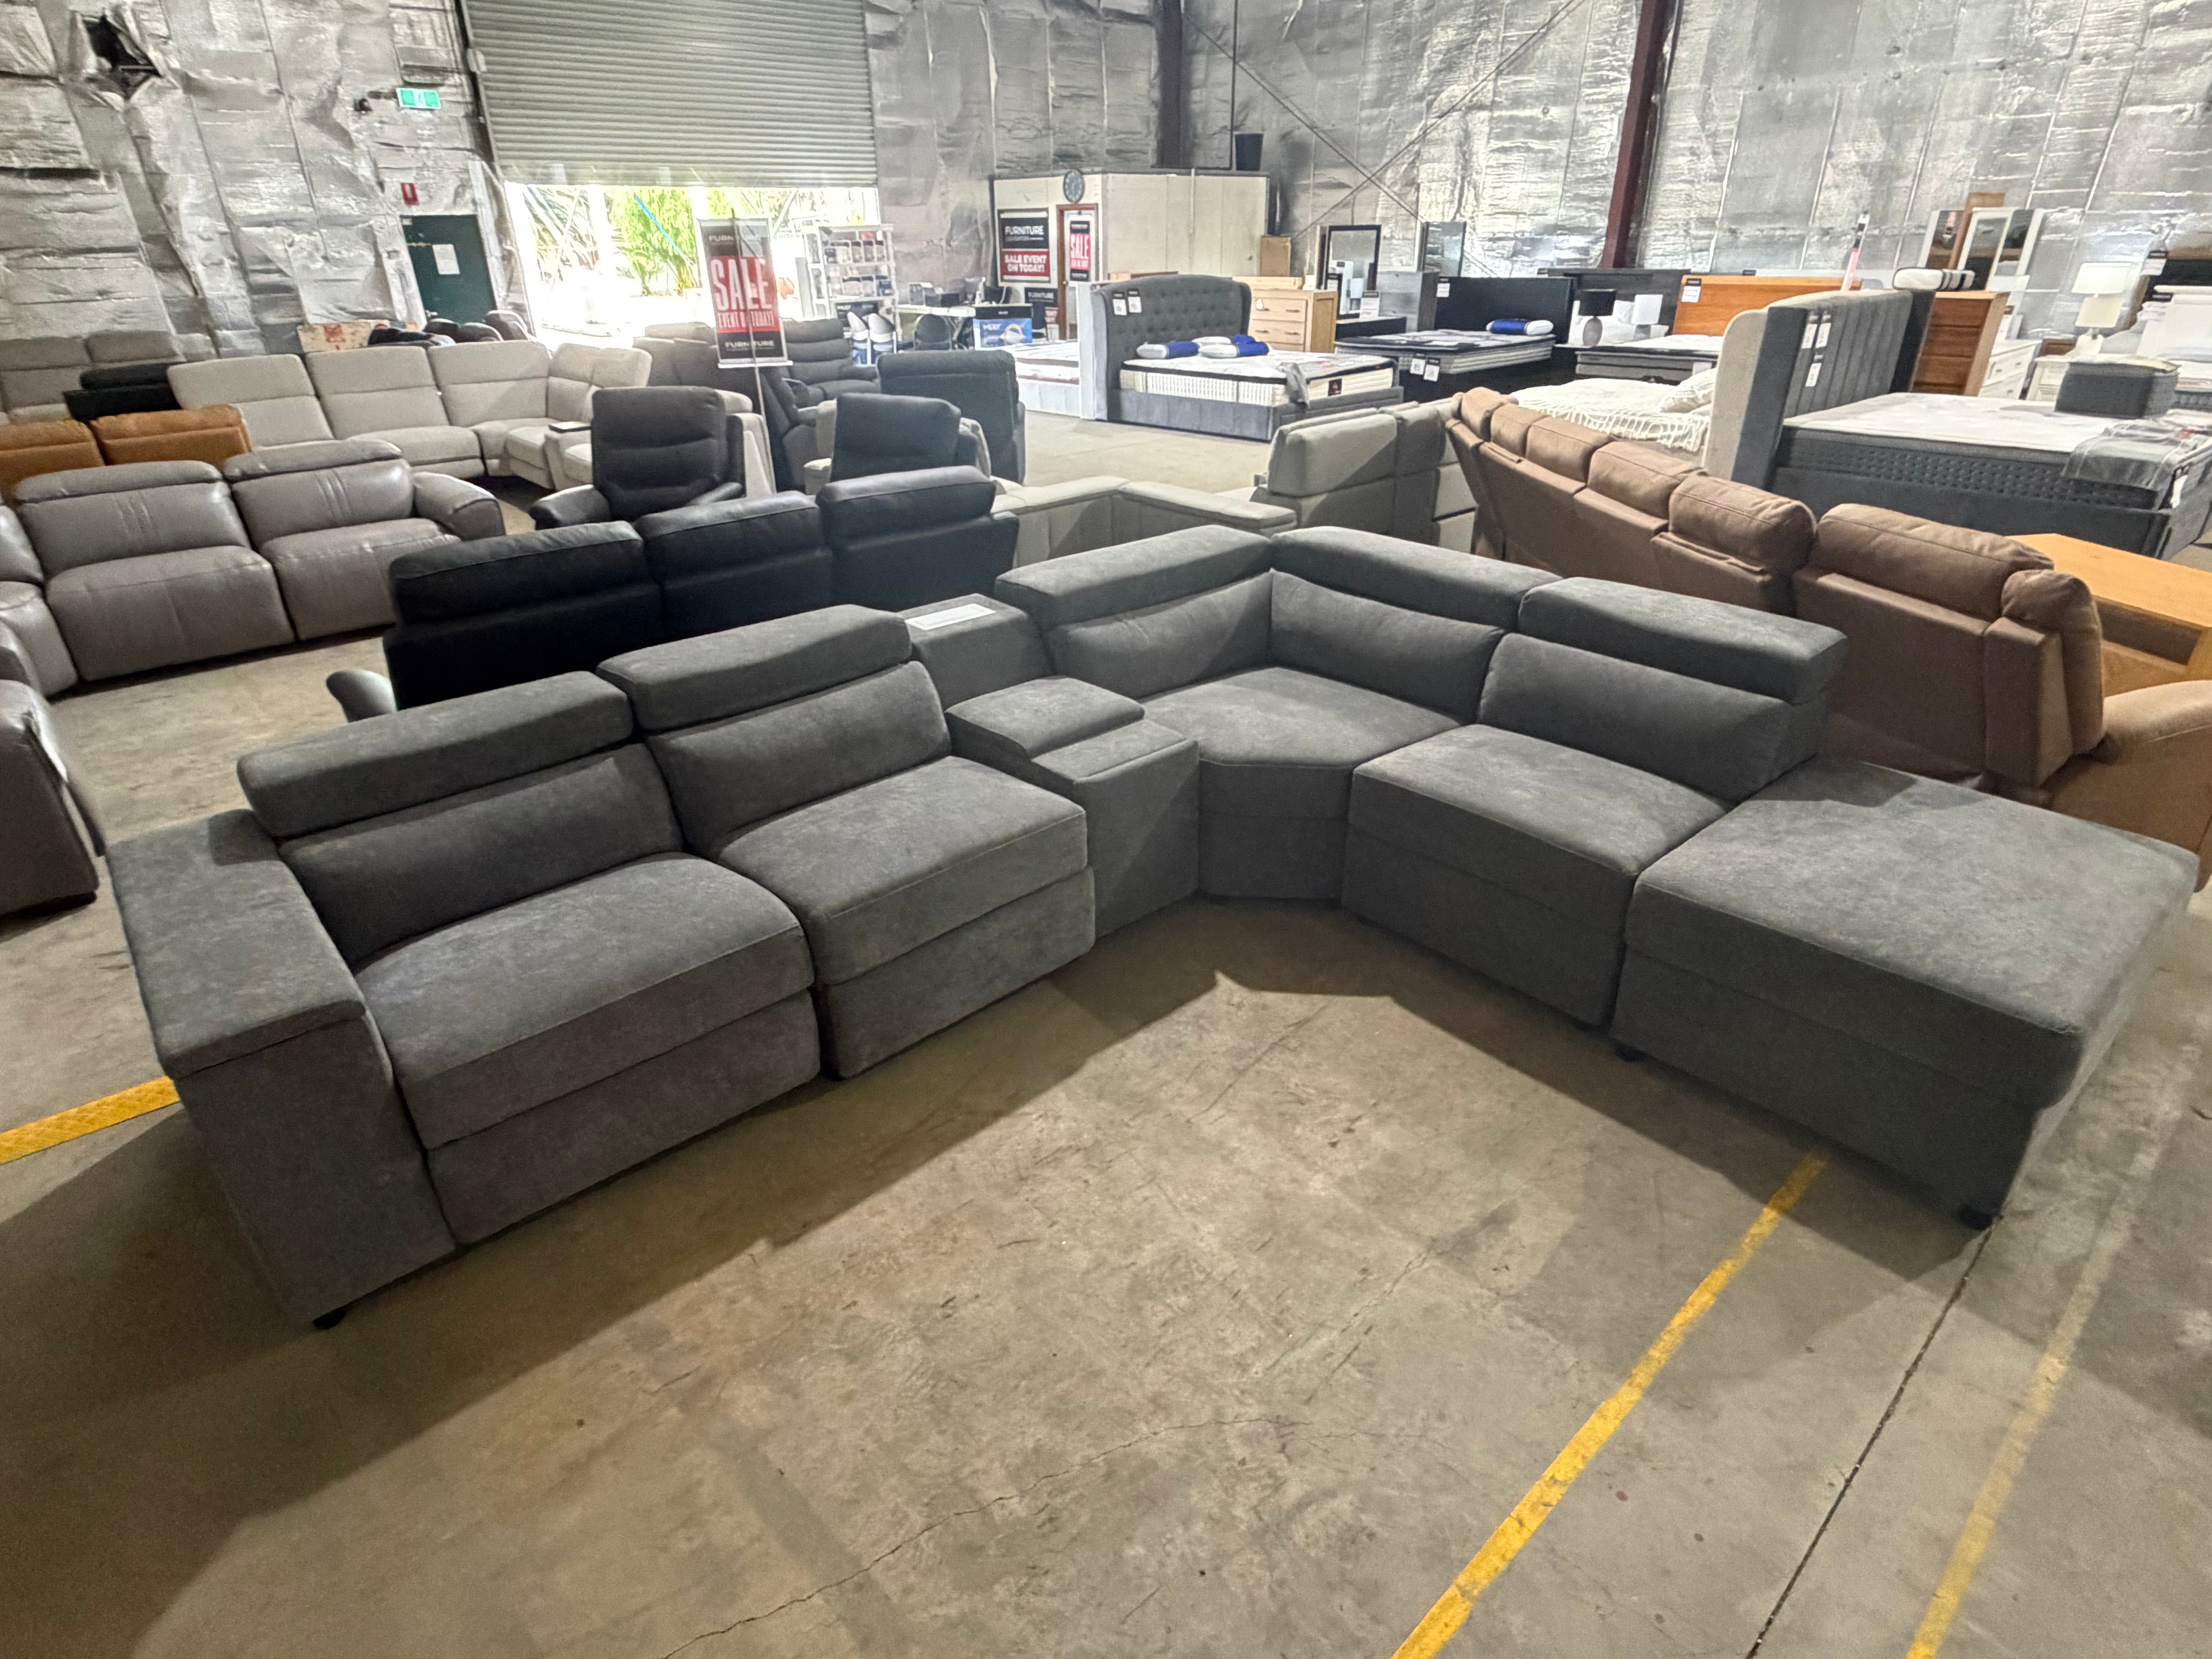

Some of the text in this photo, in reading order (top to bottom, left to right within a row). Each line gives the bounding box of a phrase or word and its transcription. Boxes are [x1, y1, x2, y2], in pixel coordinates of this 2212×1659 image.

[1005, 225, 1044, 235] FURNITURE
[1070, 234, 1089, 259] SALE
[1005, 254, 1047, 263] SALE EVENT
[1007, 264, 1045, 273] ON TODAY!
[710, 259, 773, 311] SALE
